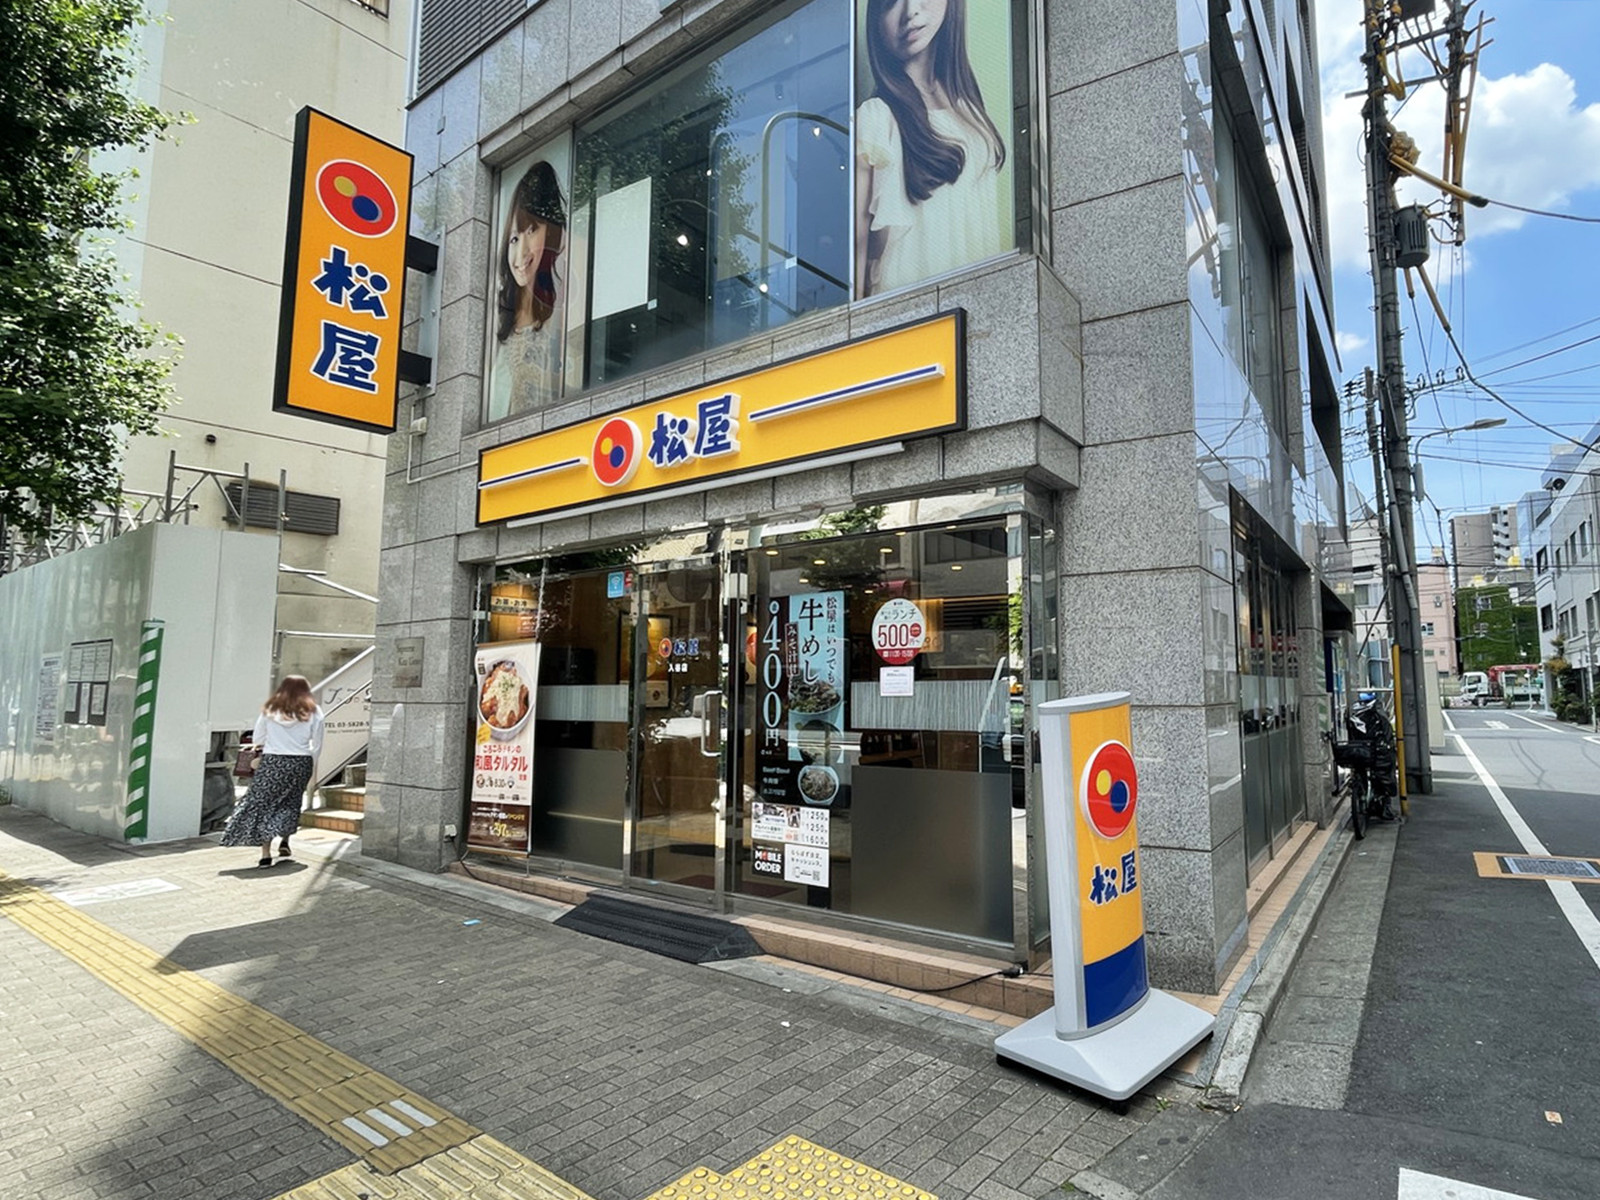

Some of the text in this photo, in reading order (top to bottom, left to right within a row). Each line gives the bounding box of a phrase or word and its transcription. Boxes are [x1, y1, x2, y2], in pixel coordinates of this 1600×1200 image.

[312, 245, 390, 394] 松屋
[648, 393, 741, 469] 松屋
[799, 598, 824, 684] 牛めし
[826, 597, 838, 684] 松屋はいつでも
[892, 608, 917, 620] ランチ
[754, 861, 782, 874] ORDER
[1089, 850, 1139, 906] 松屋
